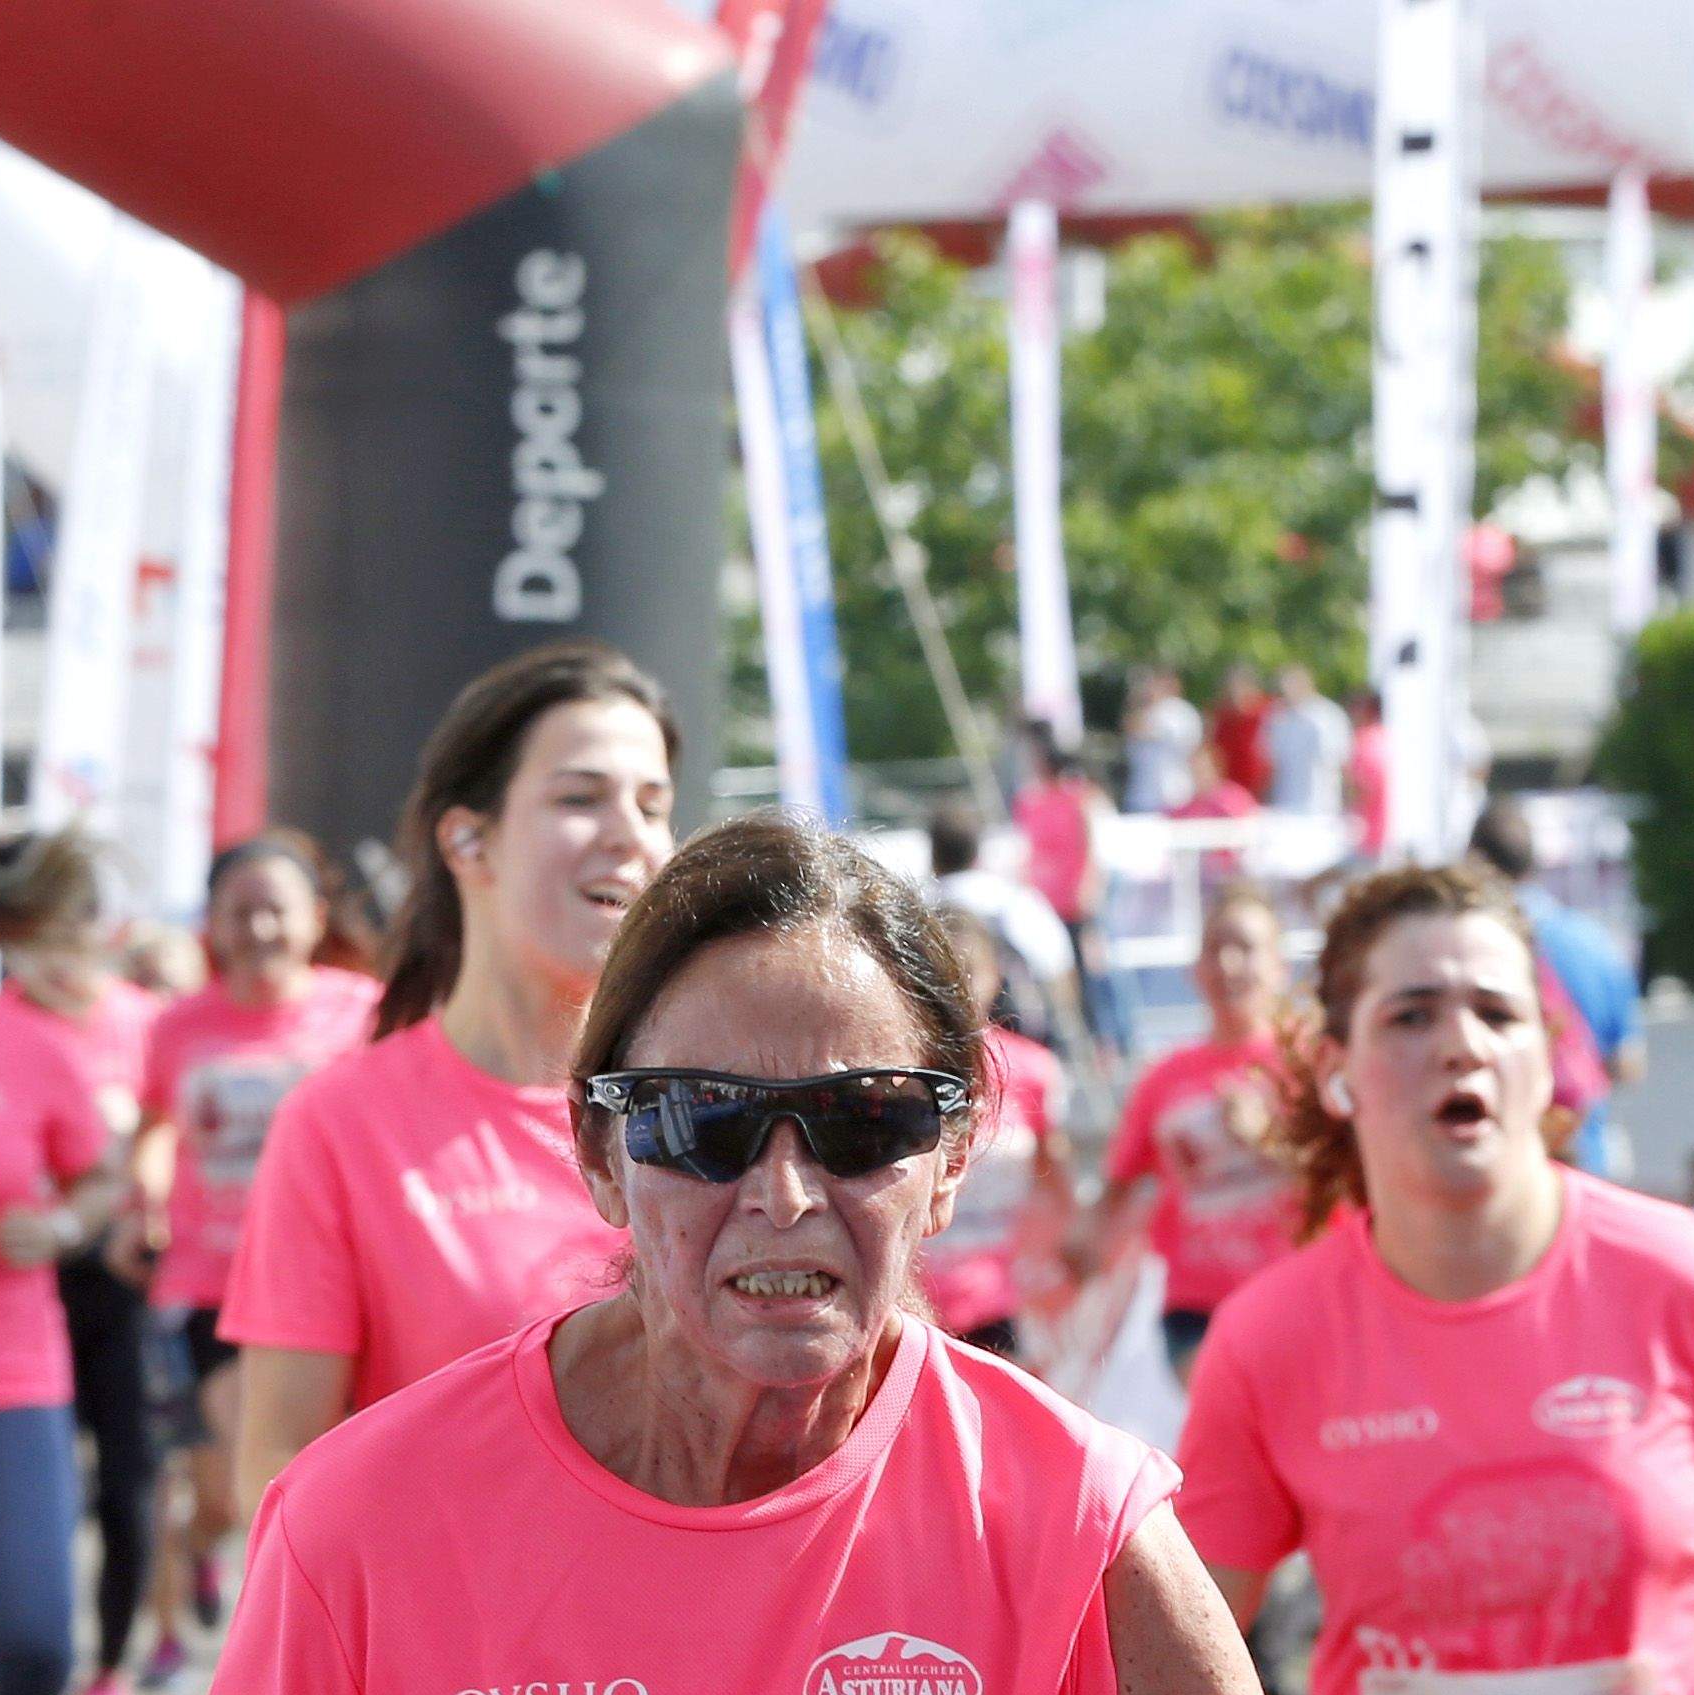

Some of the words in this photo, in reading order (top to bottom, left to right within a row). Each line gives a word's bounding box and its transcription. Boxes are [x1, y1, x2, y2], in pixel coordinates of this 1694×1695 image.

[494, 247, 607, 624] Deporte
[843, 1665, 901, 1676] CENTRAL
[905, 1665, 964, 1676] LECHERA
